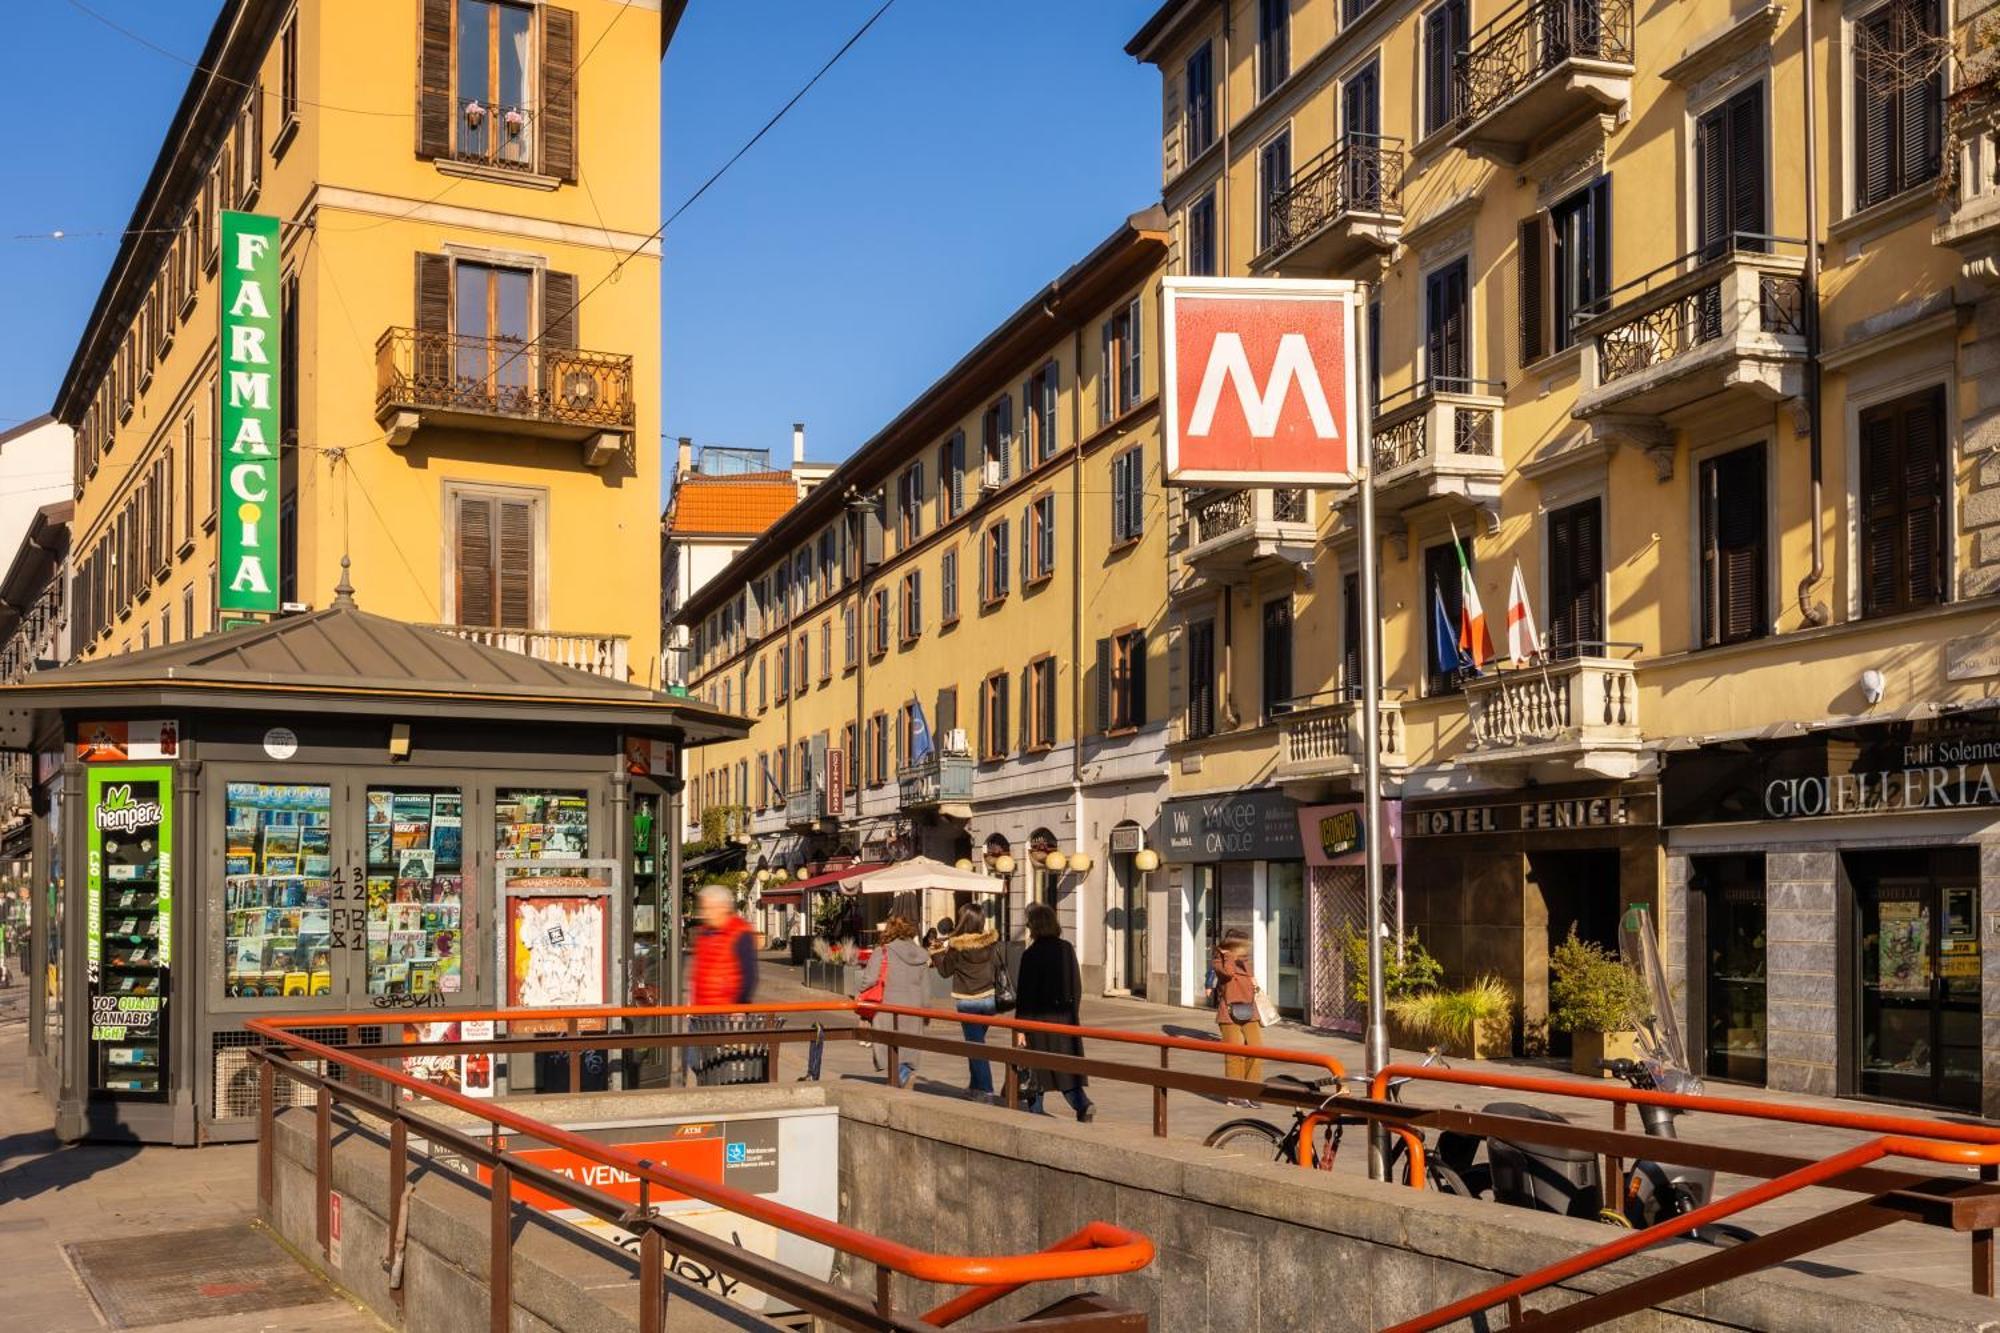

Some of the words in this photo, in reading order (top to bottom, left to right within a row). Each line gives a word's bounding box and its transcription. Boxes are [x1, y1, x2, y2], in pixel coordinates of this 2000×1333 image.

[1187, 332, 1339, 439] M
[229, 233, 271, 593] FARMACIA
[1764, 762, 2000, 818] GIOIELLERIA
[1416, 808, 1496, 835] HOTEL
[1520, 799, 1626, 830] FENICE
[159, 851, 170, 899] MILANO
[88, 889, 100, 935] BUENOS
[92, 1012, 151, 1026] CANNABIS
[93, 997, 117, 1011] TOP
[92, 1026, 127, 1040] LIGHT
[684, 1127, 702, 1135] ATM
